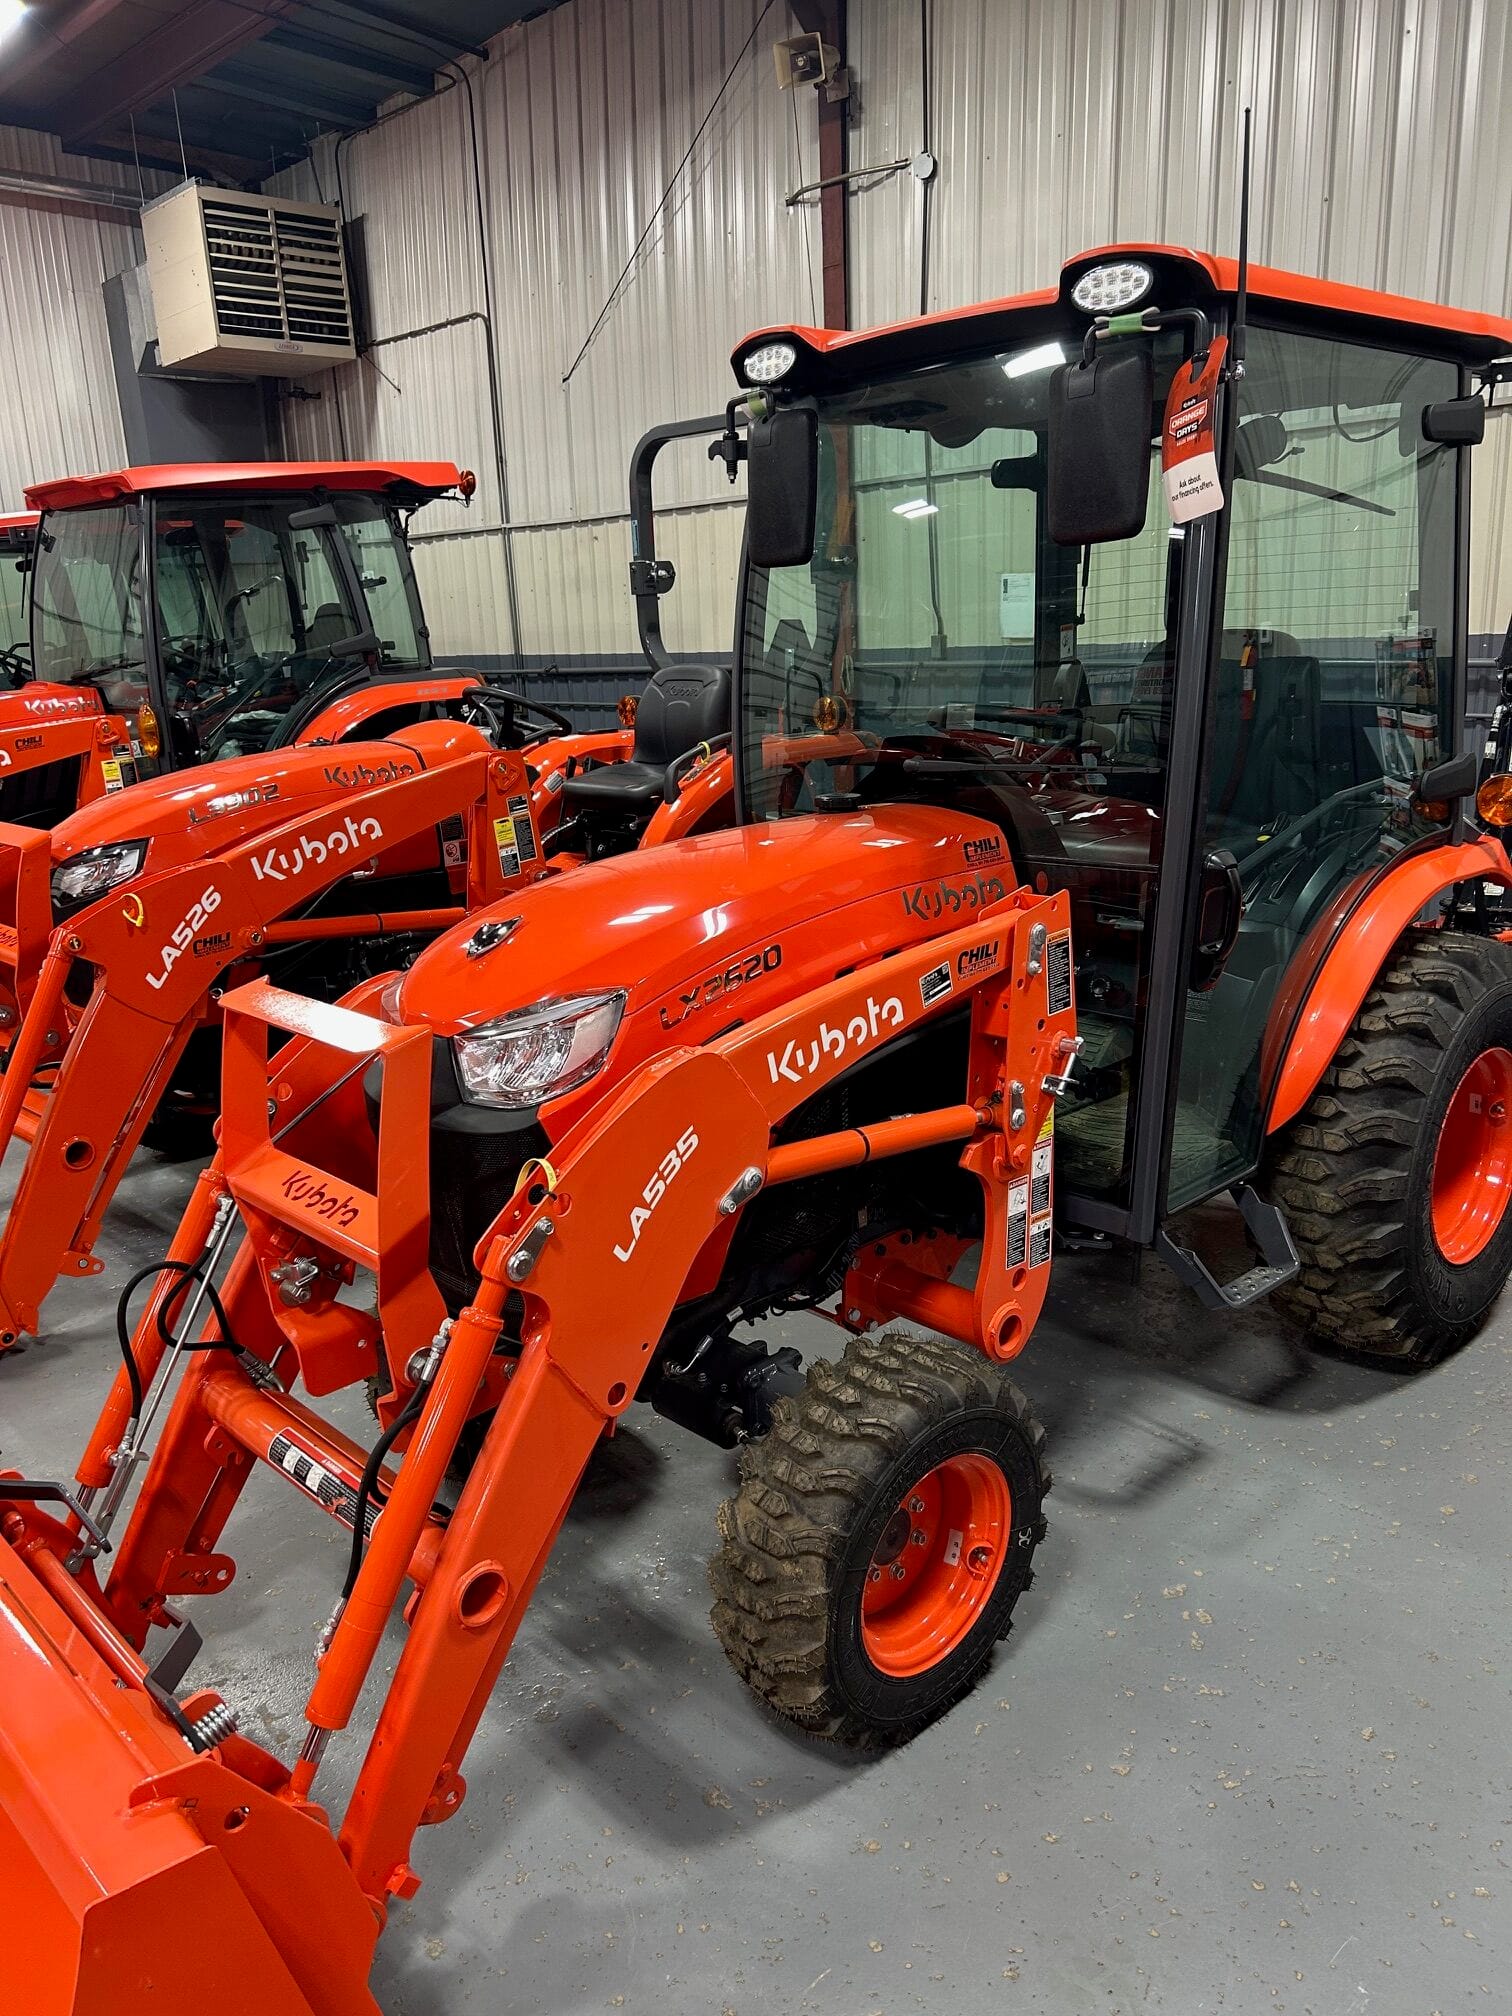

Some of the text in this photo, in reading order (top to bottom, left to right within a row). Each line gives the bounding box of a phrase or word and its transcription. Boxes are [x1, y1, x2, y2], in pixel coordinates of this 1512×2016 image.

[1172, 407, 1205, 428] ORANGE
[1176, 422, 1198, 438] DAYS
[1179, 474, 1201, 488] Ask about
[1179, 486, 1200, 499] financing
[323, 760, 415, 787] Kubota
[251, 816, 383, 881] Kubota
[963, 836, 1000, 863] CHILI
[902, 873, 1005, 921] Kubota
[145, 884, 222, 989] LA526
[192, 931, 231, 955] CHILI
[957, 940, 999, 976] CHILI
[659, 944, 782, 1030] LX2620
[766, 997, 904, 1083] Kubota
[281, 1170, 360, 1228] Kubota
[612, 1124, 700, 1262] LA535
